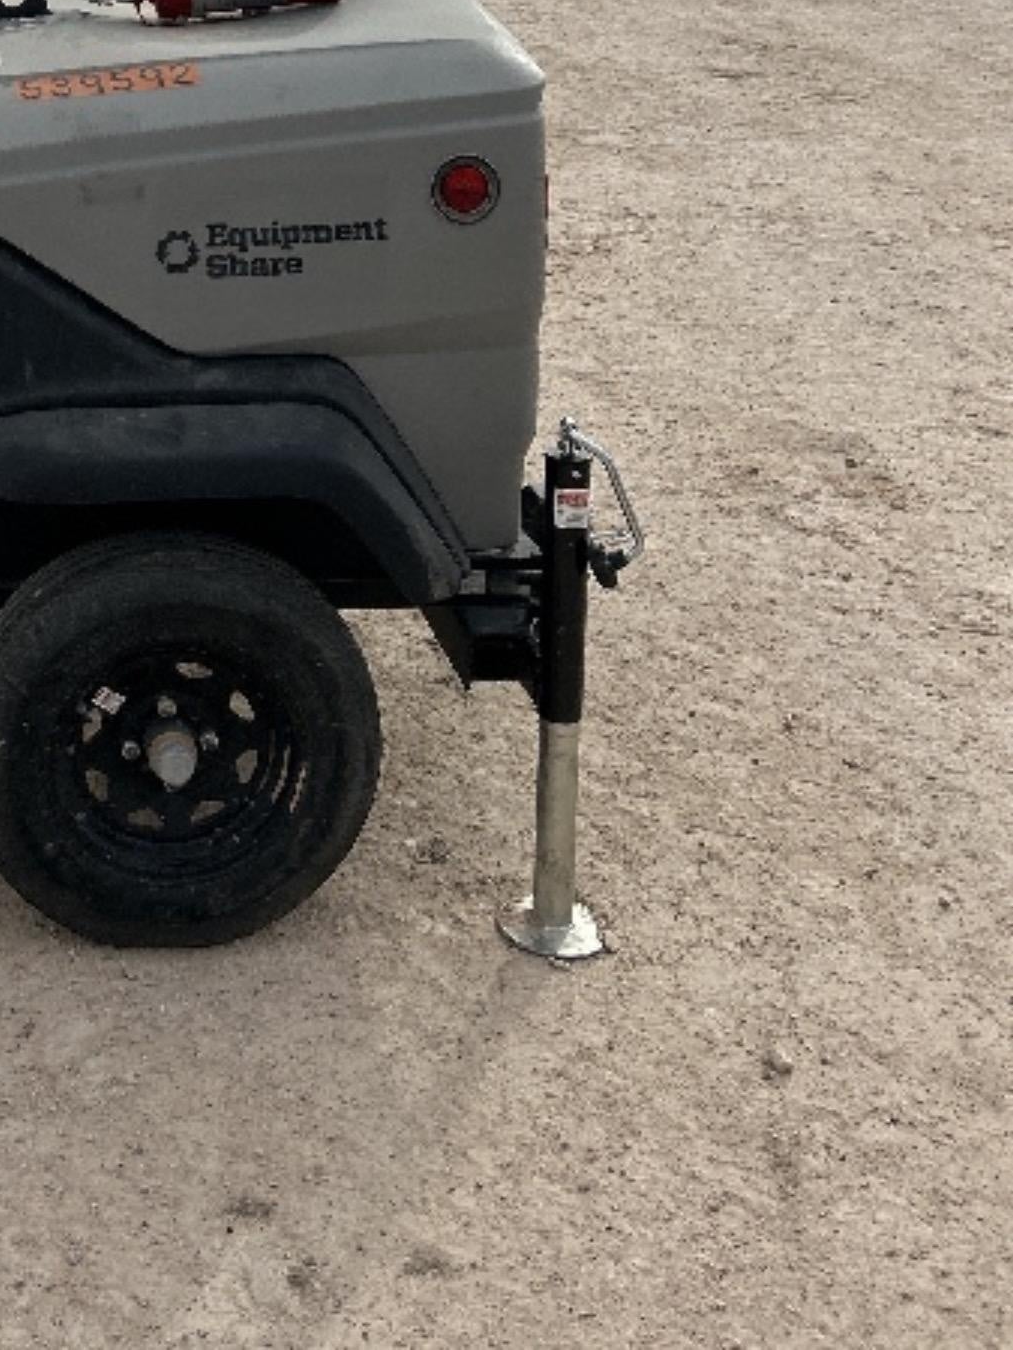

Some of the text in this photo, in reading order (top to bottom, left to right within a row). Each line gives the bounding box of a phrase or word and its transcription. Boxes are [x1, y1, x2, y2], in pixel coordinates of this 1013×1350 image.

[19, 62, 196, 100] 539592
[205, 218, 390, 252] Equipment
[205, 254, 303, 279] Share
